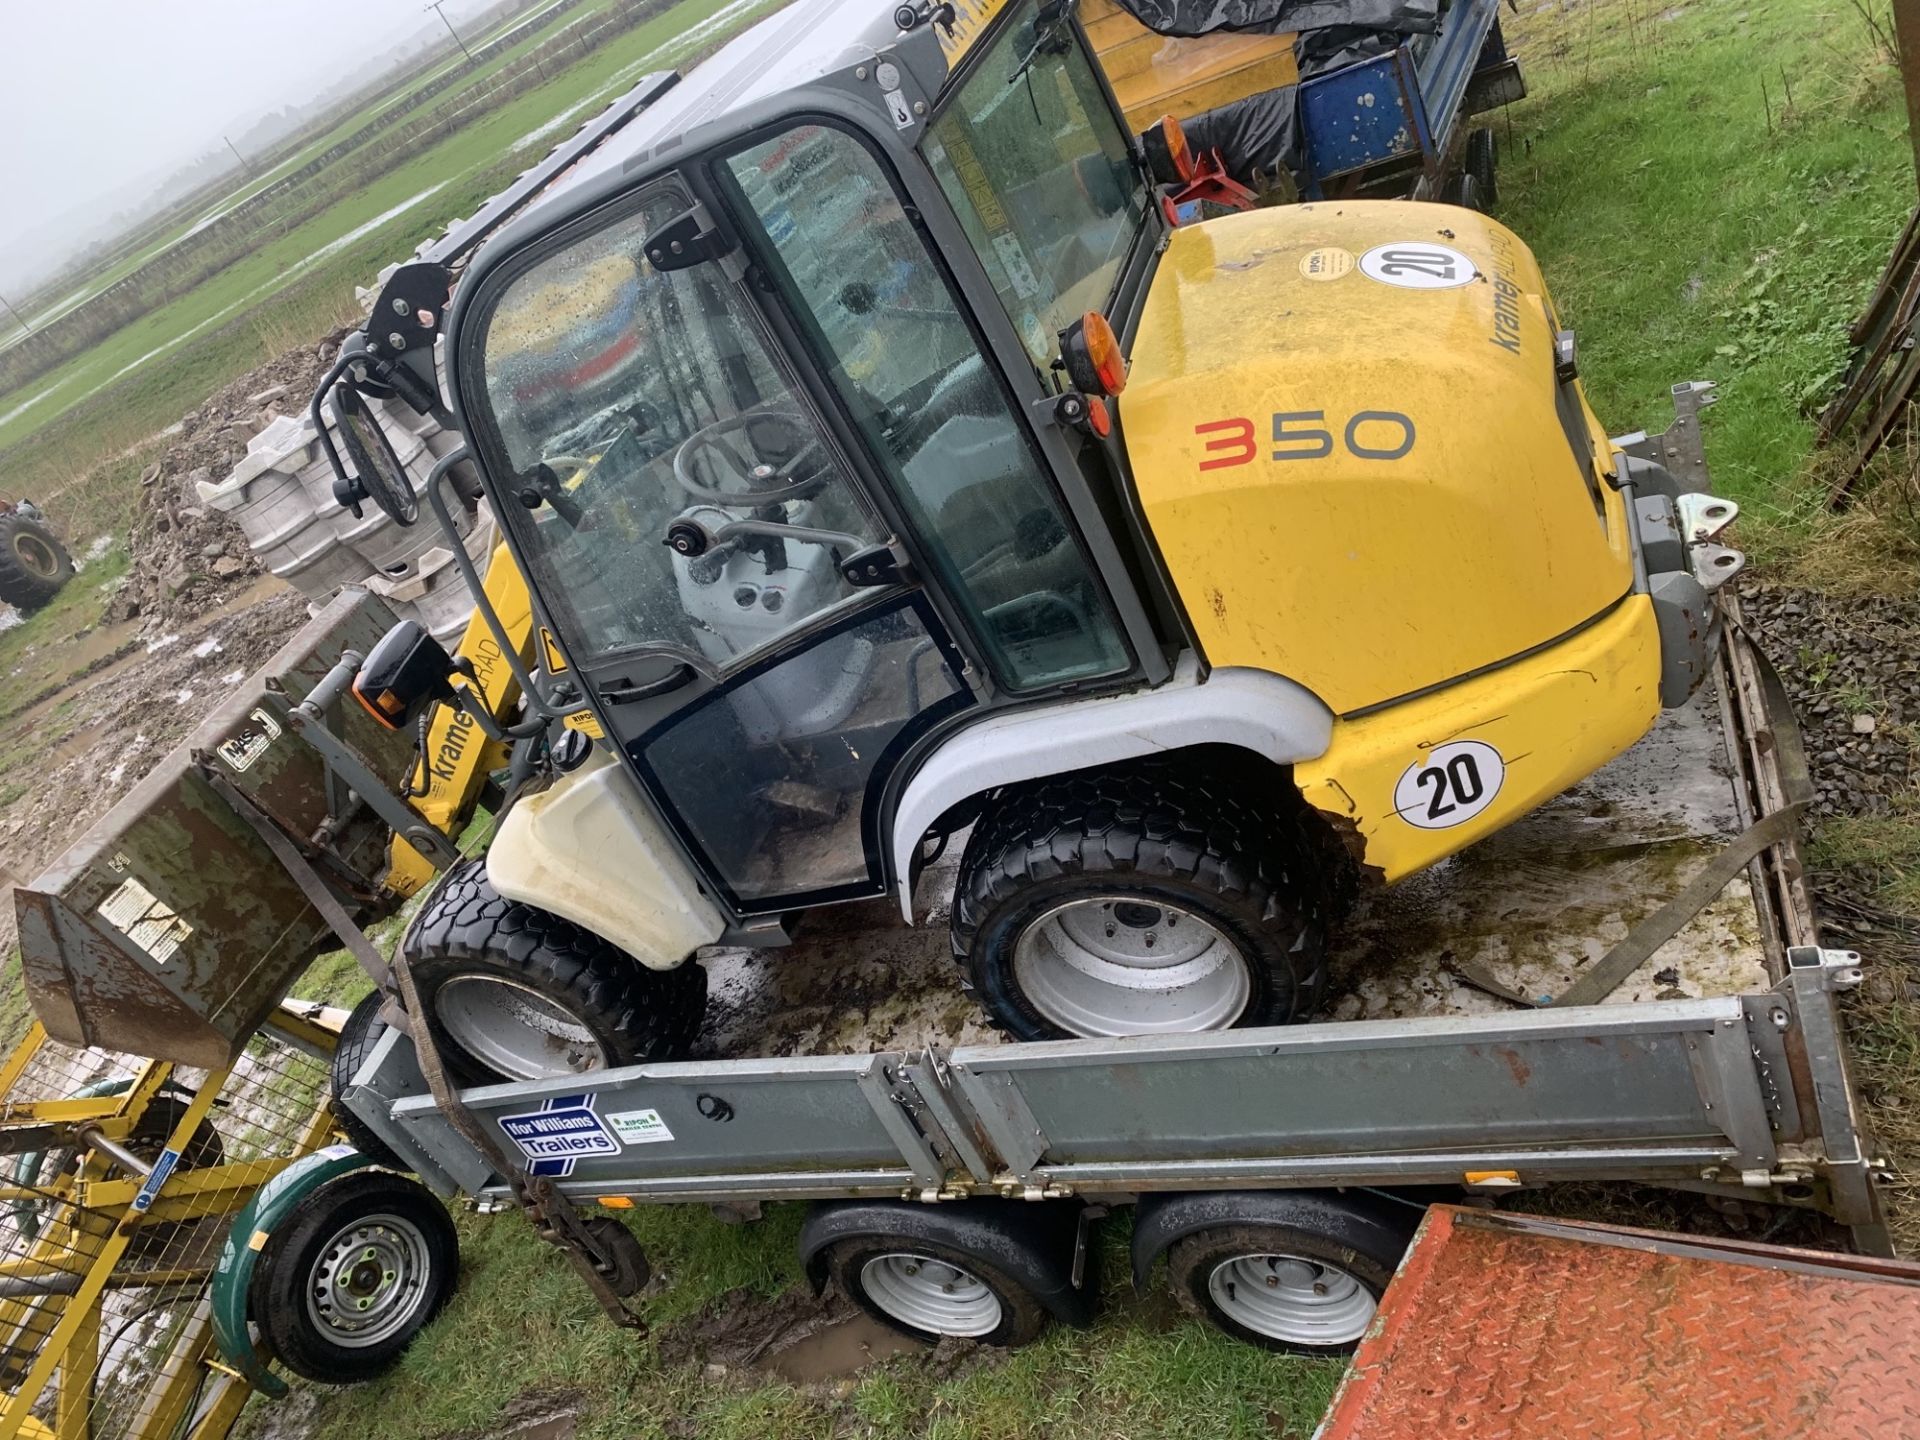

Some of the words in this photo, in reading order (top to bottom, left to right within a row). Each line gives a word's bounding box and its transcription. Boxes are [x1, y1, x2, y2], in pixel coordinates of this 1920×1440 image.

[1380, 250, 1456, 280] 20
[1488, 272, 1521, 356] kramer
[1195, 410, 1416, 471] 350
[429, 711, 474, 781] krame
[1416, 753, 1484, 820] 20
[507, 1122, 533, 1136] Ifor
[530, 1115, 595, 1132] Williams
[522, 1135, 610, 1154] Trailers
[624, 1118, 649, 1126] RIPON
